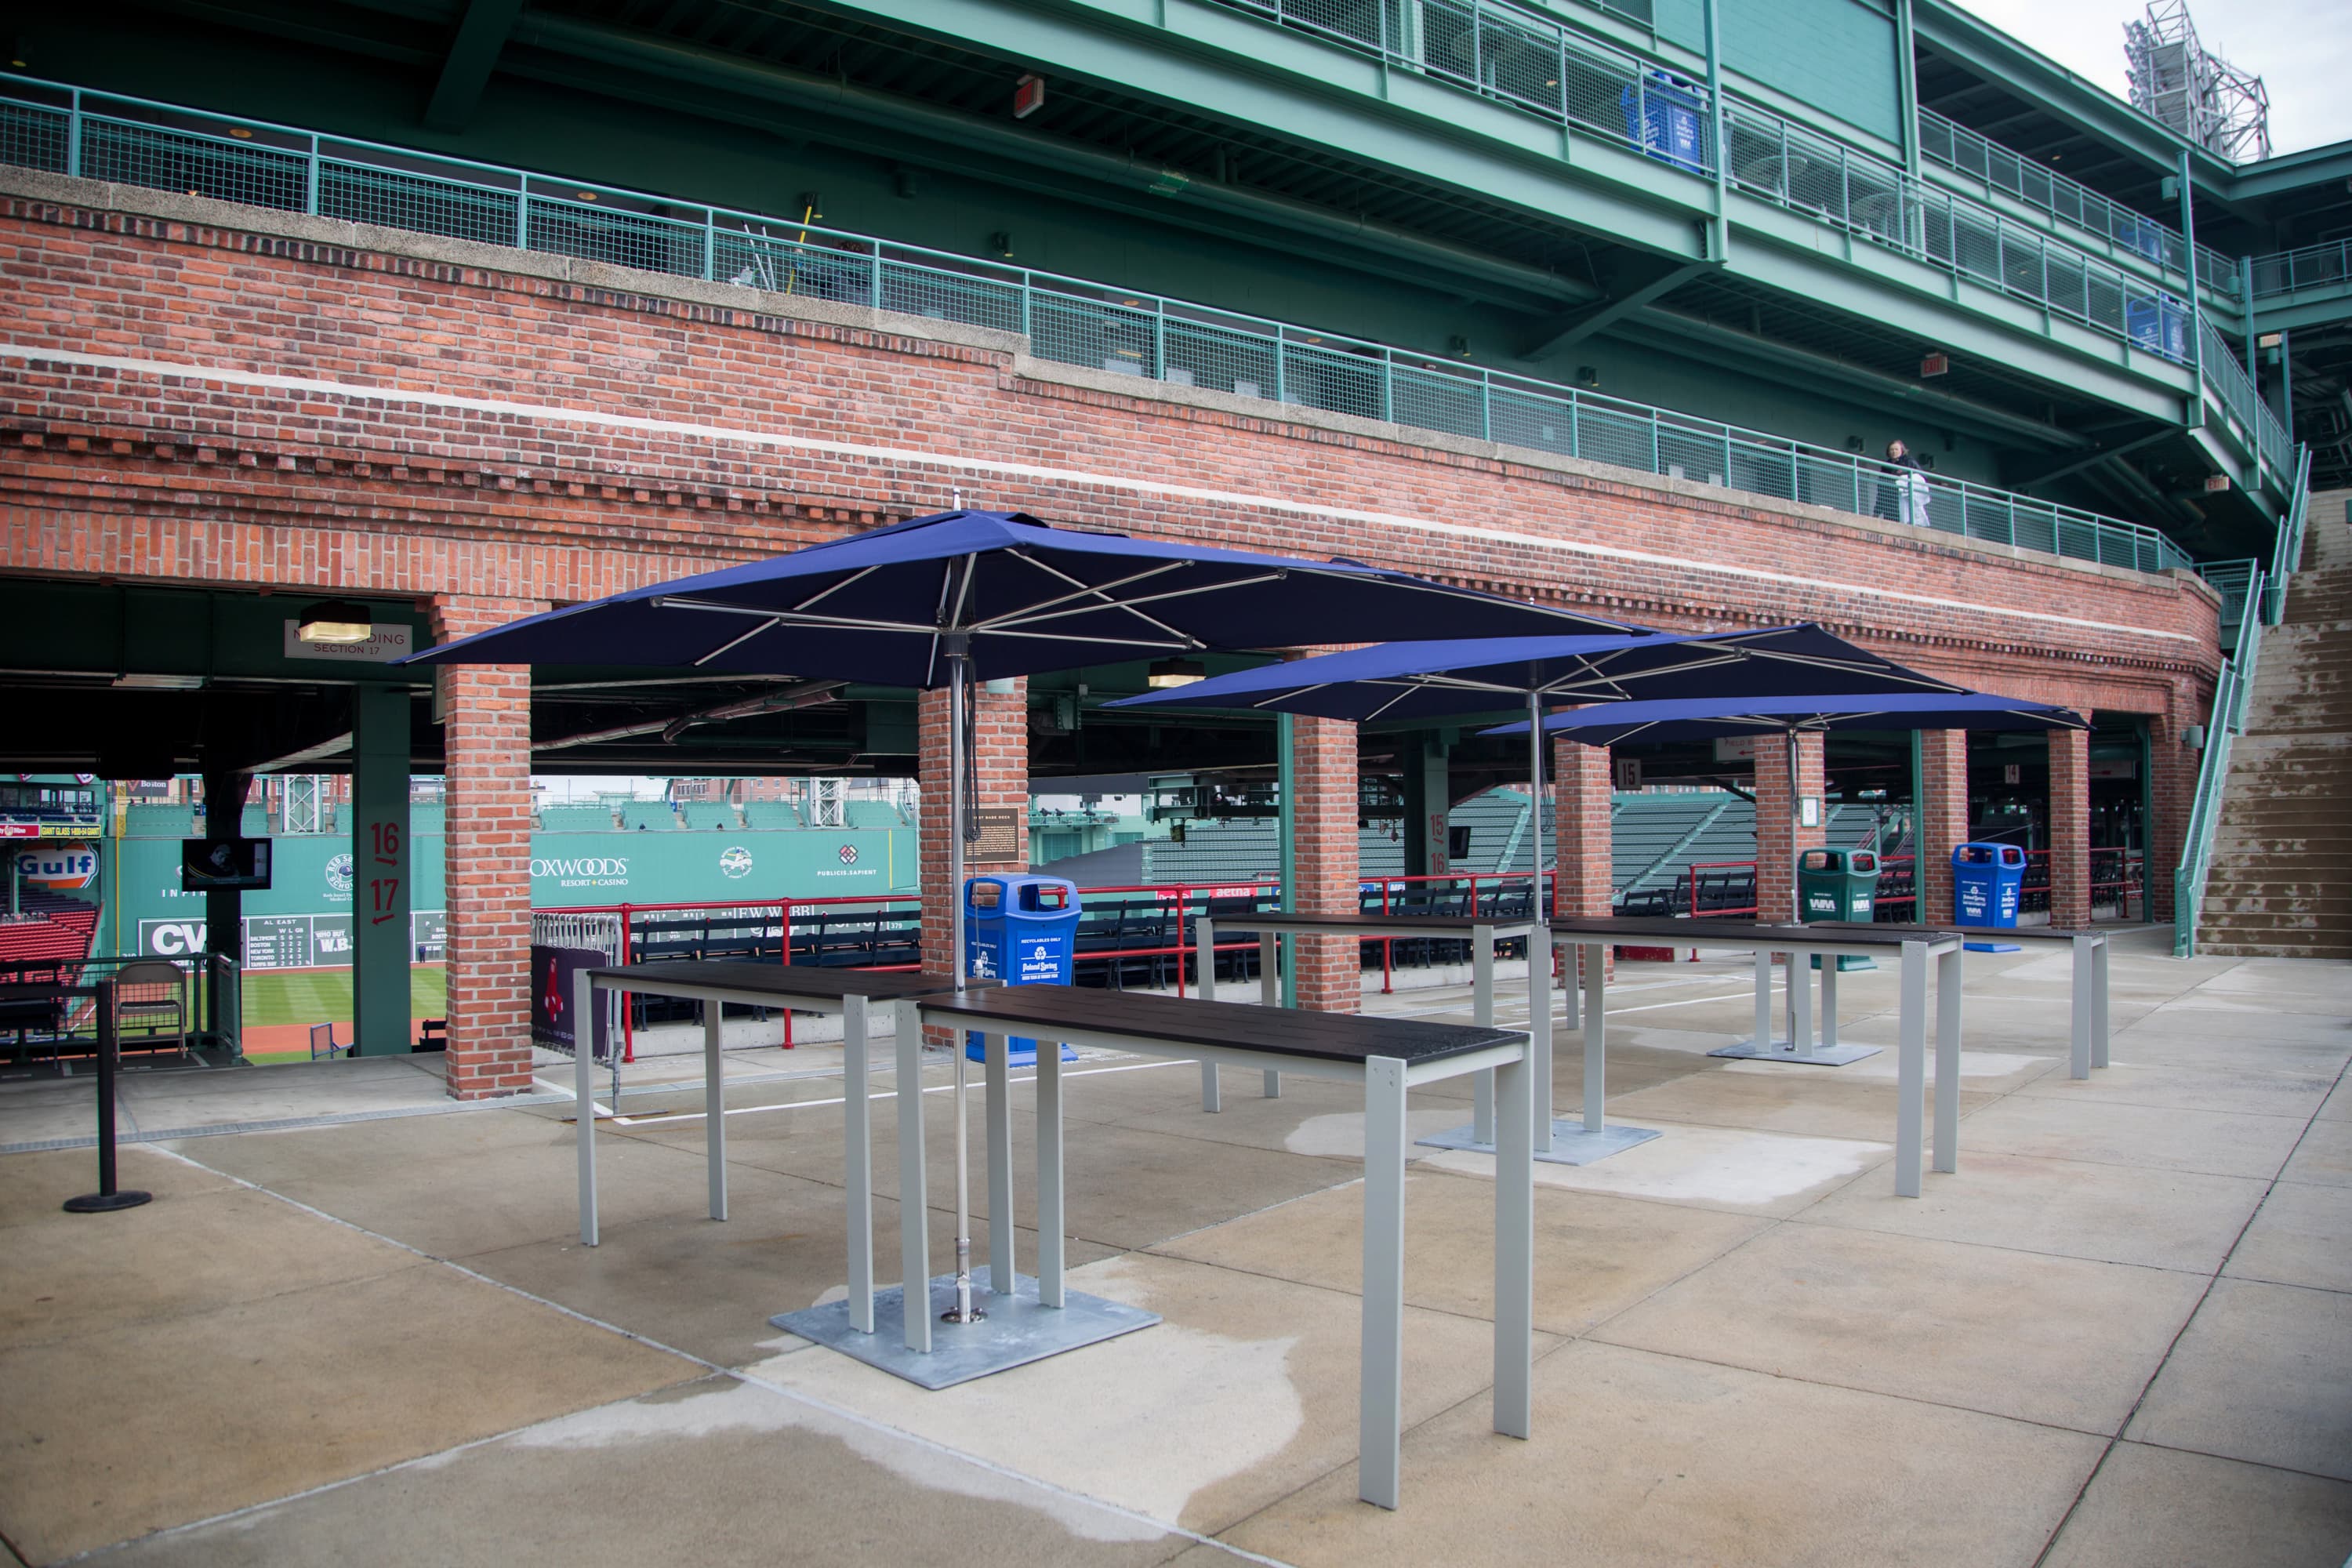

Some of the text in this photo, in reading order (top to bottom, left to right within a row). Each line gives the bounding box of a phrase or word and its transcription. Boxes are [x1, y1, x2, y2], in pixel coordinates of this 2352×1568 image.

[314, 643, 380, 655] SECTION 17
[1622, 763, 1635, 785] 15
[56, 826, 70, 836] GLASS
[1431, 814, 1444, 837] 15
[371, 822, 400, 855] 16
[19, 855, 93, 875] Gulf
[529, 858, 628, 877] OXWOODS
[1432, 853, 1445, 875] 16
[371, 879, 400, 911] 17
[1216, 887, 1250, 897] aetna
[1809, 898, 1836, 909] WM
[152, 924, 207, 956] CV
[1022, 962, 1058, 972] Poland Spring
